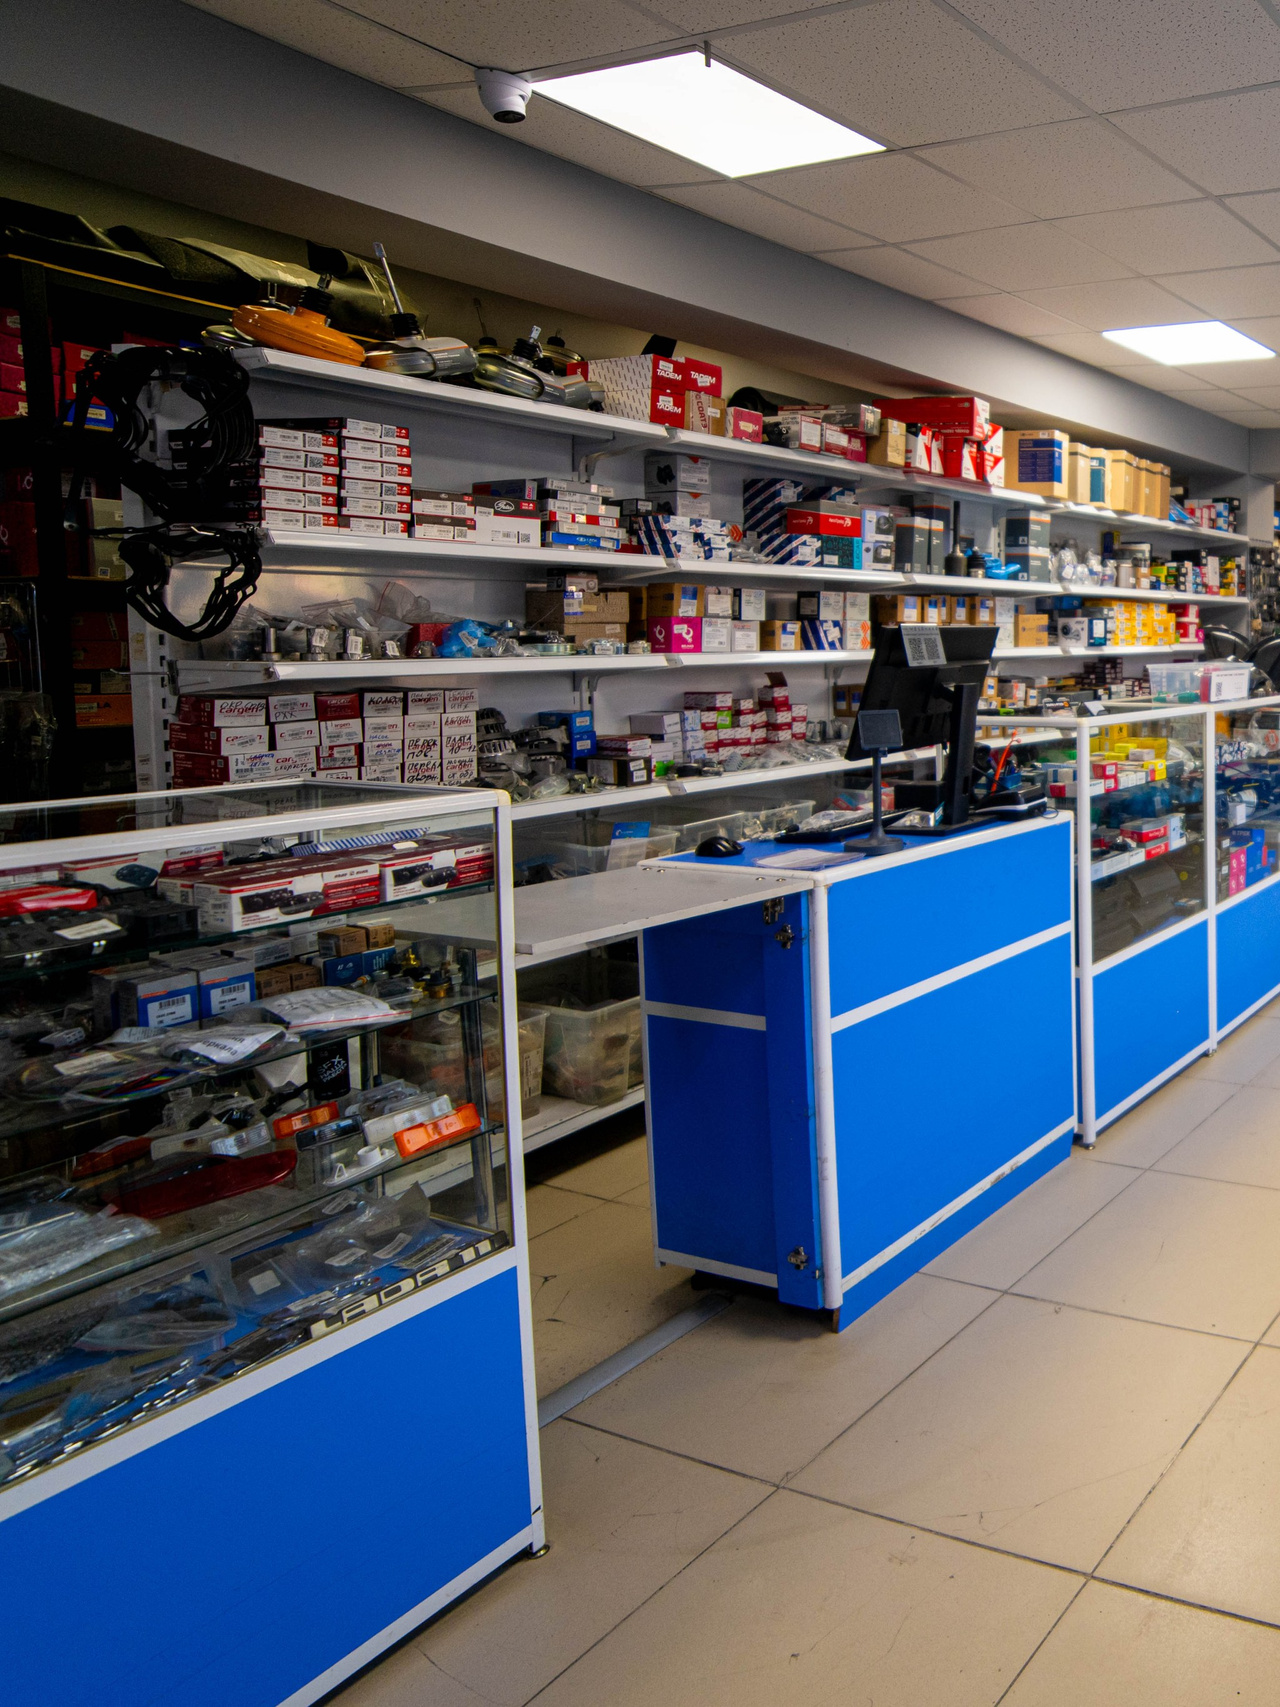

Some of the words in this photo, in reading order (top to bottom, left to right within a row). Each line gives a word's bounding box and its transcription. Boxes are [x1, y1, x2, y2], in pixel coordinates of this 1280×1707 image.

[657, 369, 682, 381] TADEM
[657, 402, 682, 414] TADEM
[199, 1038, 238, 1056] еркала
[310, 1259, 450, 1339] LADA
